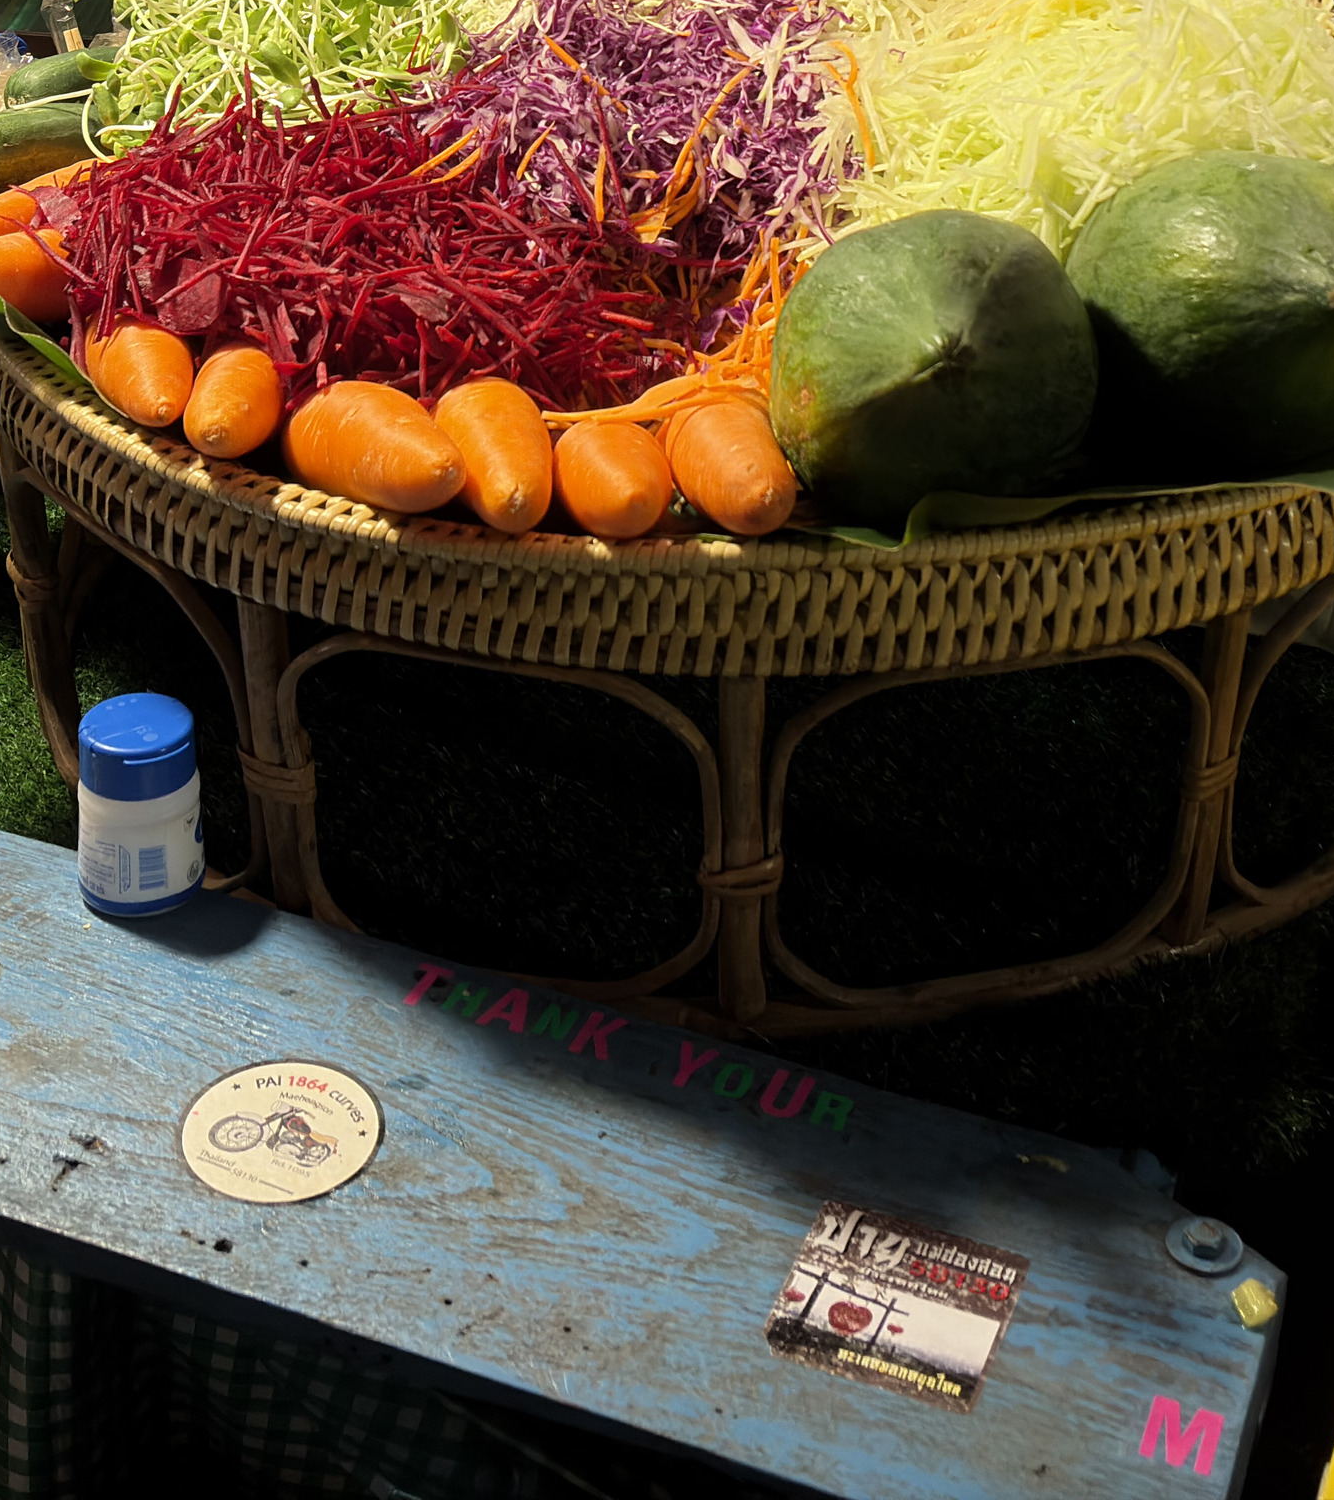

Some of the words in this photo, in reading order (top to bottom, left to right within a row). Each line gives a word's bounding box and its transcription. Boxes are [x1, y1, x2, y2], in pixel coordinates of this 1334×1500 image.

[403, 961, 628, 1061] THANK
[669, 1039, 855, 1131] YOUR
[256, 1075, 282, 1089] PAI
[288, 1075, 328, 1093] 1864
[329, 1089, 365, 1123] curves
[279, 1091, 334, 1115] Maehongson
[199, 1149, 236, 1167] Thailand
[232, 1166, 258, 1183] 58130
[1139, 1394, 1225, 1478] M
